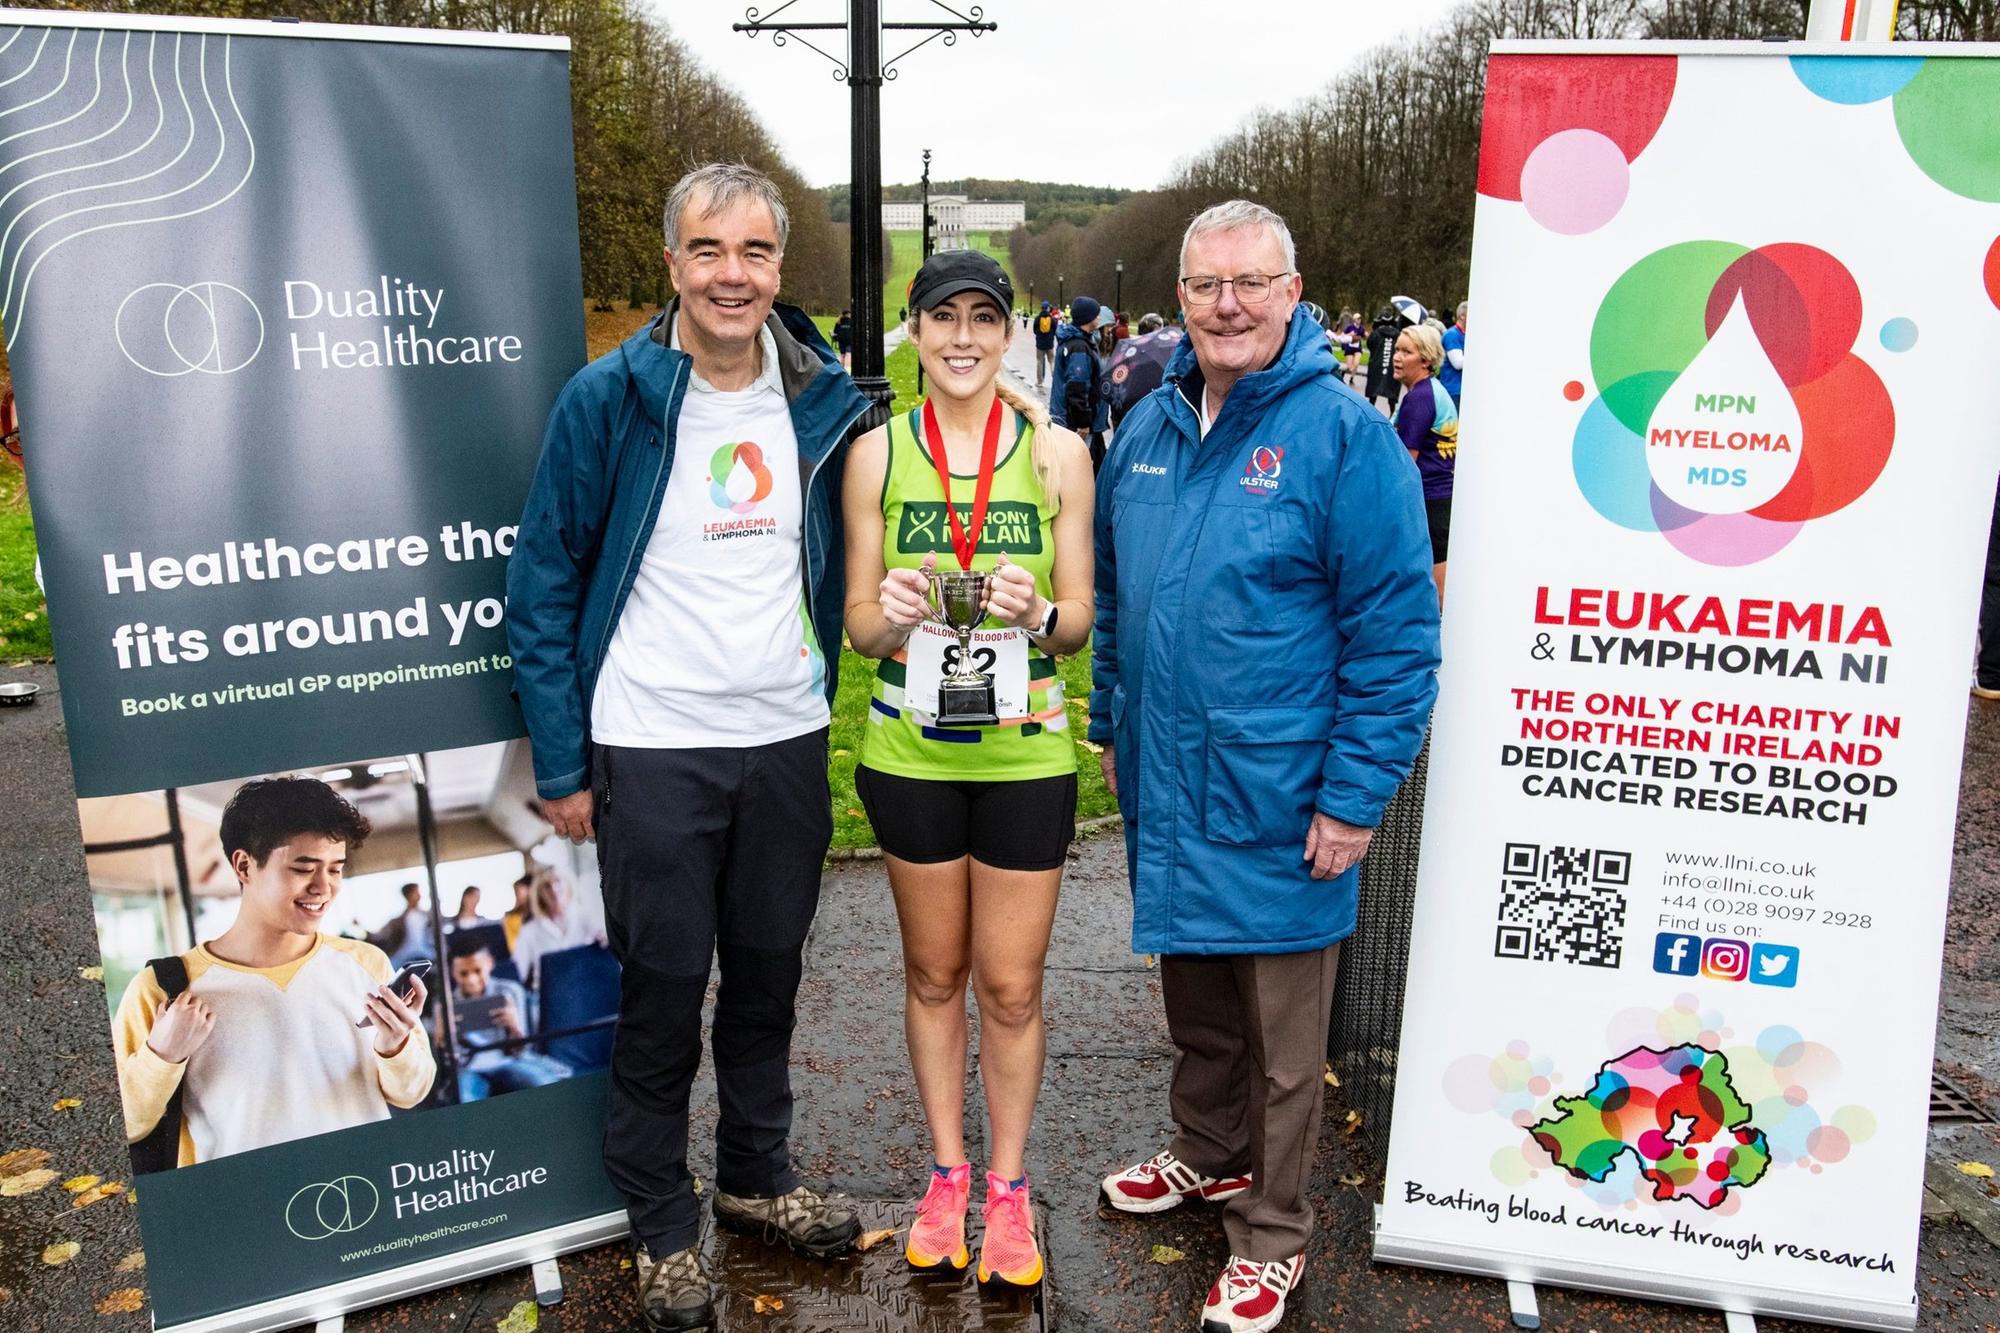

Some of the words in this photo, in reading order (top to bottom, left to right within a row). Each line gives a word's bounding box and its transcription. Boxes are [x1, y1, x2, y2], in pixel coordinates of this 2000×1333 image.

[284, 275, 444, 328] Duality
[289, 325, 522, 370] Healthcare
[1694, 393, 1756, 415] MPN
[1650, 428, 1792, 453] MYELOMA
[1240, 477, 1279, 490] ULSTER
[1687, 466, 1748, 488] MDS
[702, 534, 710, 542] &
[711, 528, 764, 541] LYMPHOMA
[766, 528, 777, 536] NI
[703, 518, 777, 533] LEUKAEMIA
[943, 510, 1029, 525] ANHONY
[102, 533, 430, 595] Healthcare
[440, 520, 520, 564] tha
[111, 622, 210, 669] fits
[222, 597, 429, 657] around
[439, 595, 508, 646] yo
[974, 632, 1002, 642] BLOOD
[1003, 631, 1017, 641] RUN
[1534, 586, 1892, 648] LEUKAEMIA
[1530, 632, 1556, 662] &
[1570, 634, 1823, 681] LYMPHOMA
[1839, 652, 1888, 685] NI
[121, 692, 187, 717] Book
[190, 692, 208, 708] a
[212, 676, 295, 705] virtual
[299, 674, 332, 694] GP
[336, 655, 488, 693] appointment
[1510, 687, 1575, 713] THE
[1584, 693, 1682, 721] ONLY
[1690, 701, 1853, 736] CHARITY
[1862, 714, 1901, 739] IN
[1519, 717, 1712, 753] NORTHERN
[1722, 732, 1883, 767] IRELAND
[1500, 744, 1698, 781] DEDICATED
[1709, 759, 1758, 785] TO
[1767, 765, 1898, 799] BLOOD
[1521, 774, 1663, 808] CANCER
[1673, 786, 1868, 826] RESEARCH
[1662, 871, 1816, 902] info@llni.co.uk
[1664, 850, 1817, 879] www.llni.co.uk
[1658, 913, 1701, 932] Find
[1705, 921, 1729, 935] us
[1733, 925, 1762, 937] on:
[1660, 895, 1696, 910] +44
[1703, 896, 1760, 919] (0)28
[1764, 903, 1817, 924] 9097
[1822, 909, 1873, 930] 2928
[390, 1149, 496, 1189] Duality
[393, 1164, 548, 1220] Healthcare
[339, 1212, 508, 1263] www.dualityhealthcare.com
[1403, 1180, 1501, 1224] Beating
[1507, 1194, 1568, 1226] blood
[1575, 1214, 1664, 1239] cancer
[1669, 1218, 1765, 1262] through
[1774, 1242, 1896, 1275] research
